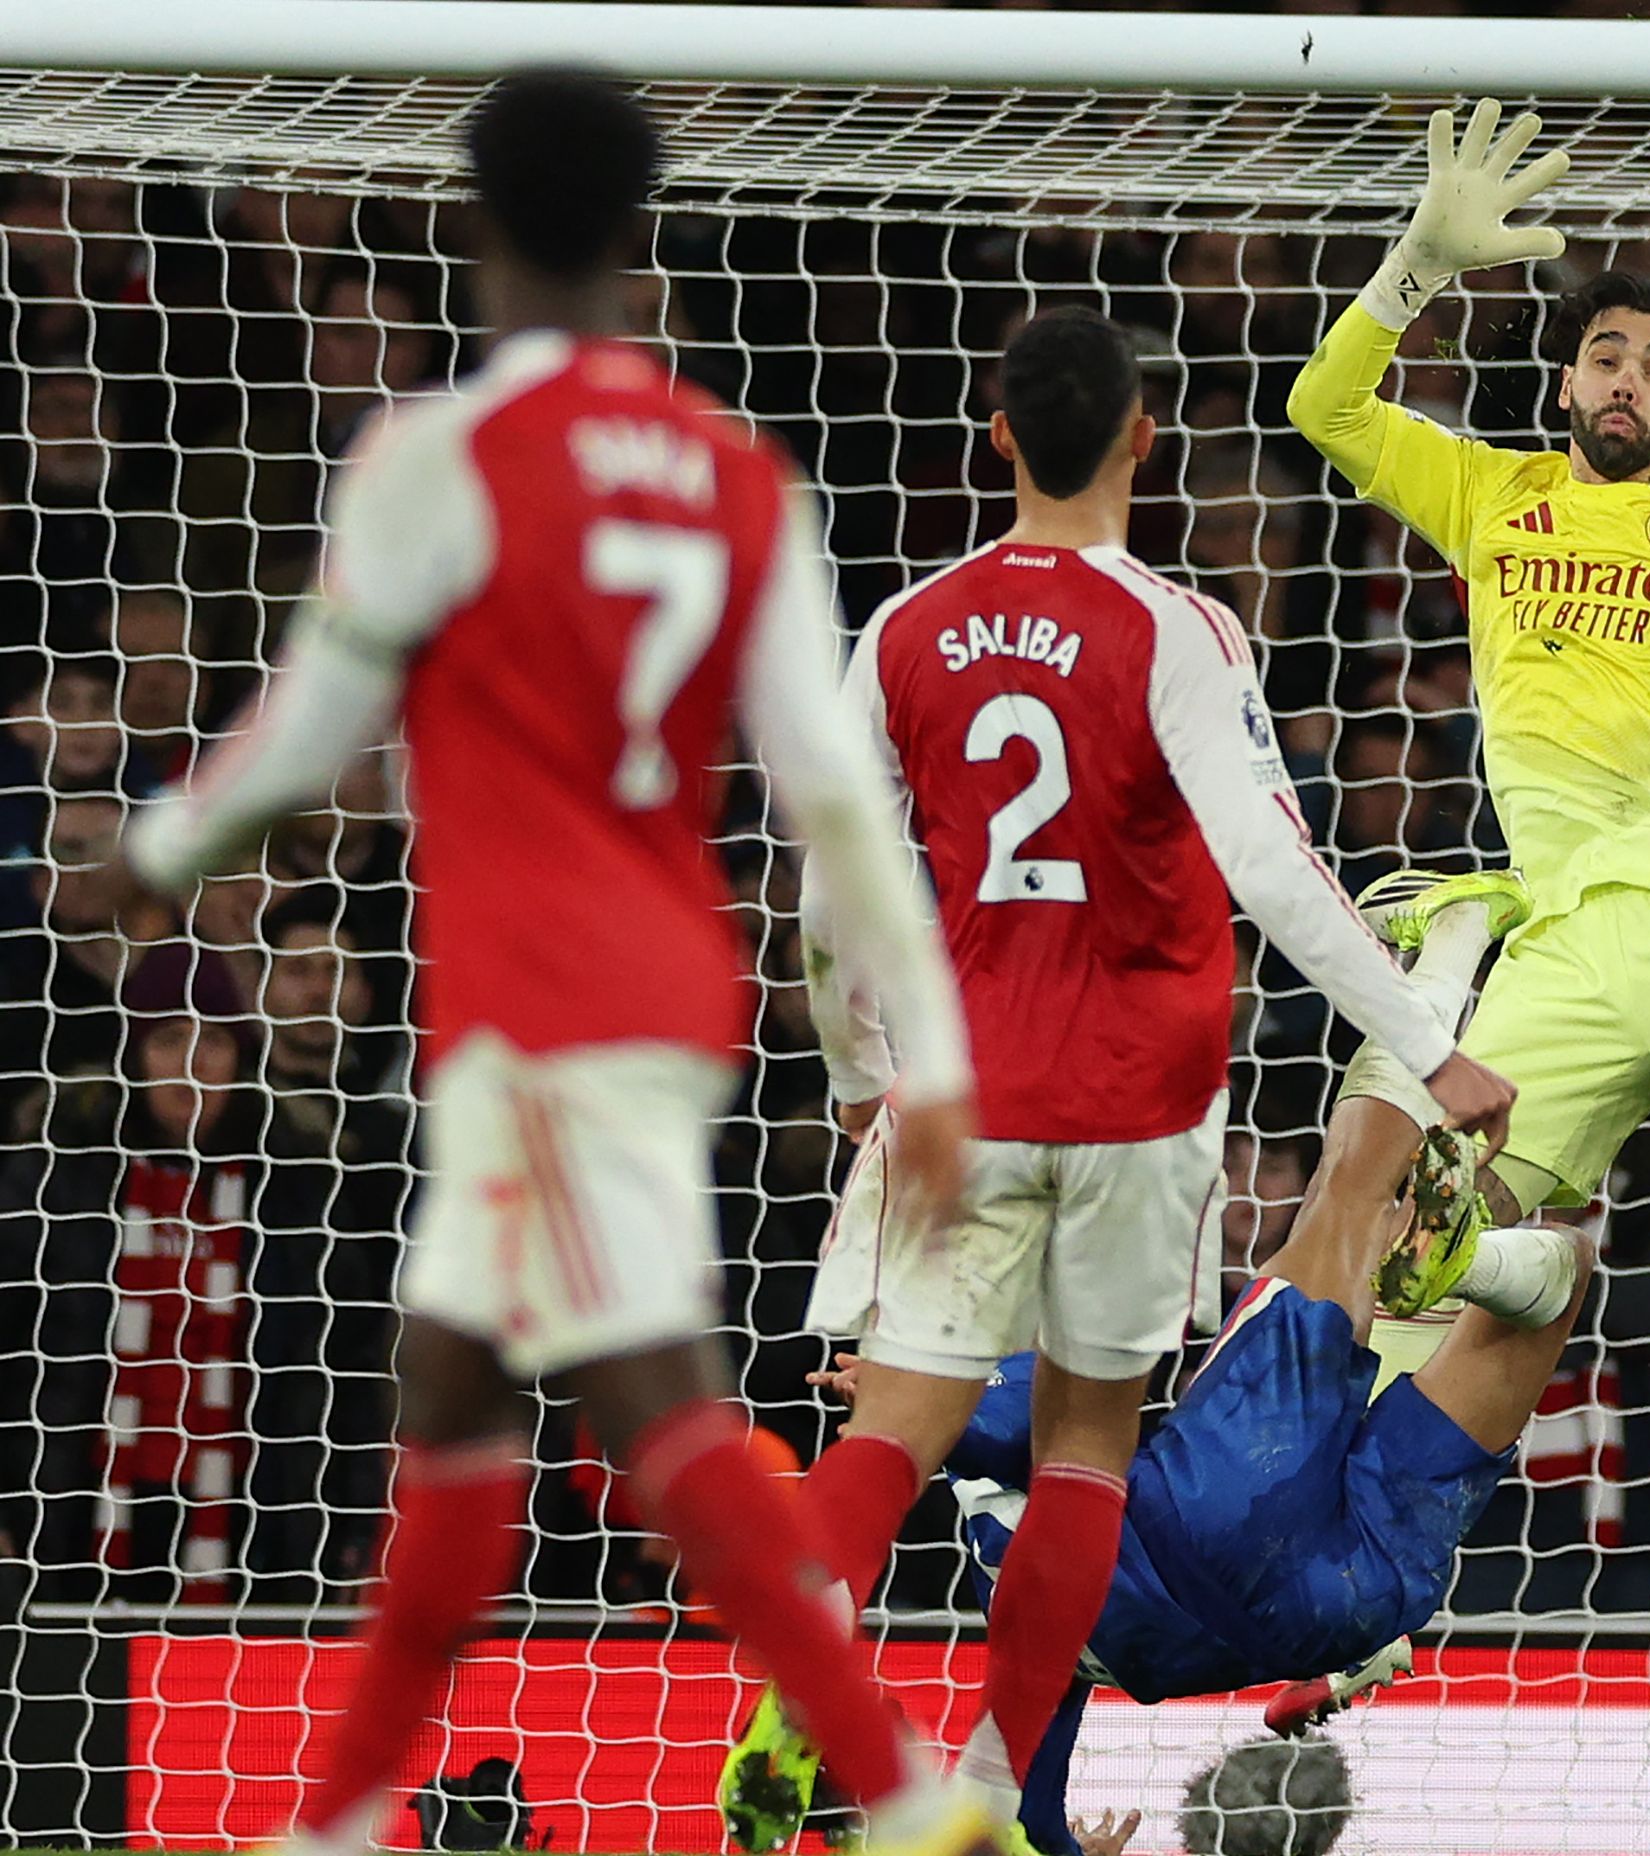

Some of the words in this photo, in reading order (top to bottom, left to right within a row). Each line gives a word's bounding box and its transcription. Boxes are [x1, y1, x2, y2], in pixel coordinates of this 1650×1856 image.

[581, 515, 732, 809] 7
[937, 613, 1083, 678] SALIBA
[1513, 600, 1549, 634] FLY
[1552, 601, 1650, 644] BETTER
[964, 692, 1088, 903] 2
